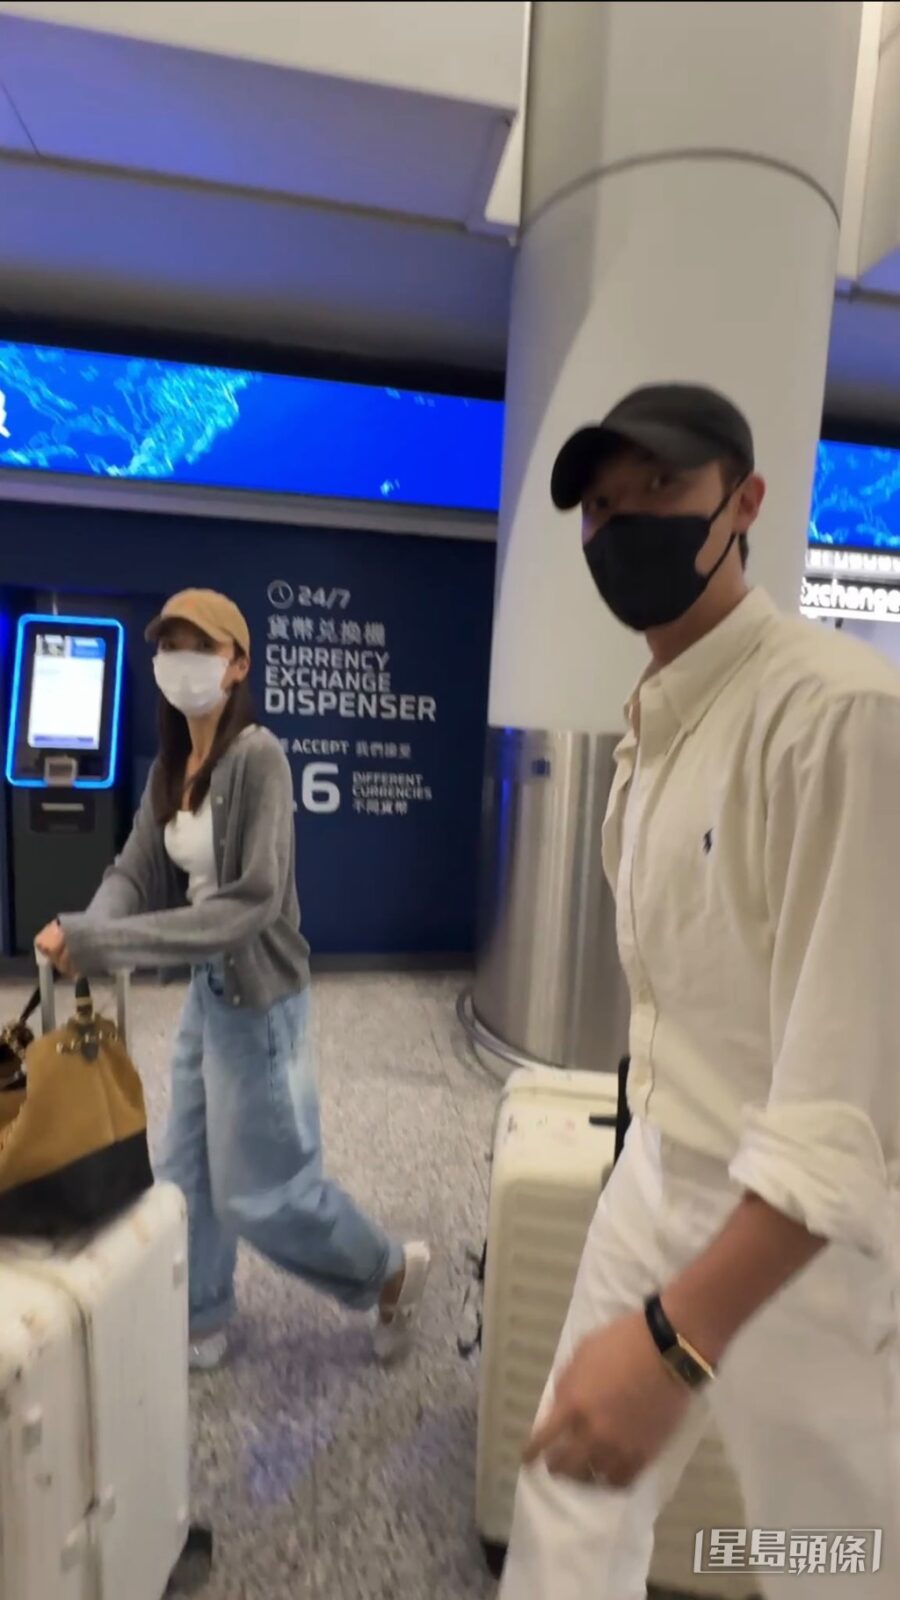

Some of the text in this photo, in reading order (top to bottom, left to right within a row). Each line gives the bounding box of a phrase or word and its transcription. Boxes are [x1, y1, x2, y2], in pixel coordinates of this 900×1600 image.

[298, 585, 351, 609] 24/7
[266, 644, 390, 672] CURRENCY
[265, 665, 391, 693] EXCHANGE
[264, 687, 437, 722] DISPENSER
[291, 738, 349, 756] ACCEPT
[292, 761, 341, 814] 6
[352, 771, 423, 788] DIFFERENT
[351, 785, 432, 801] CURRENCIES
